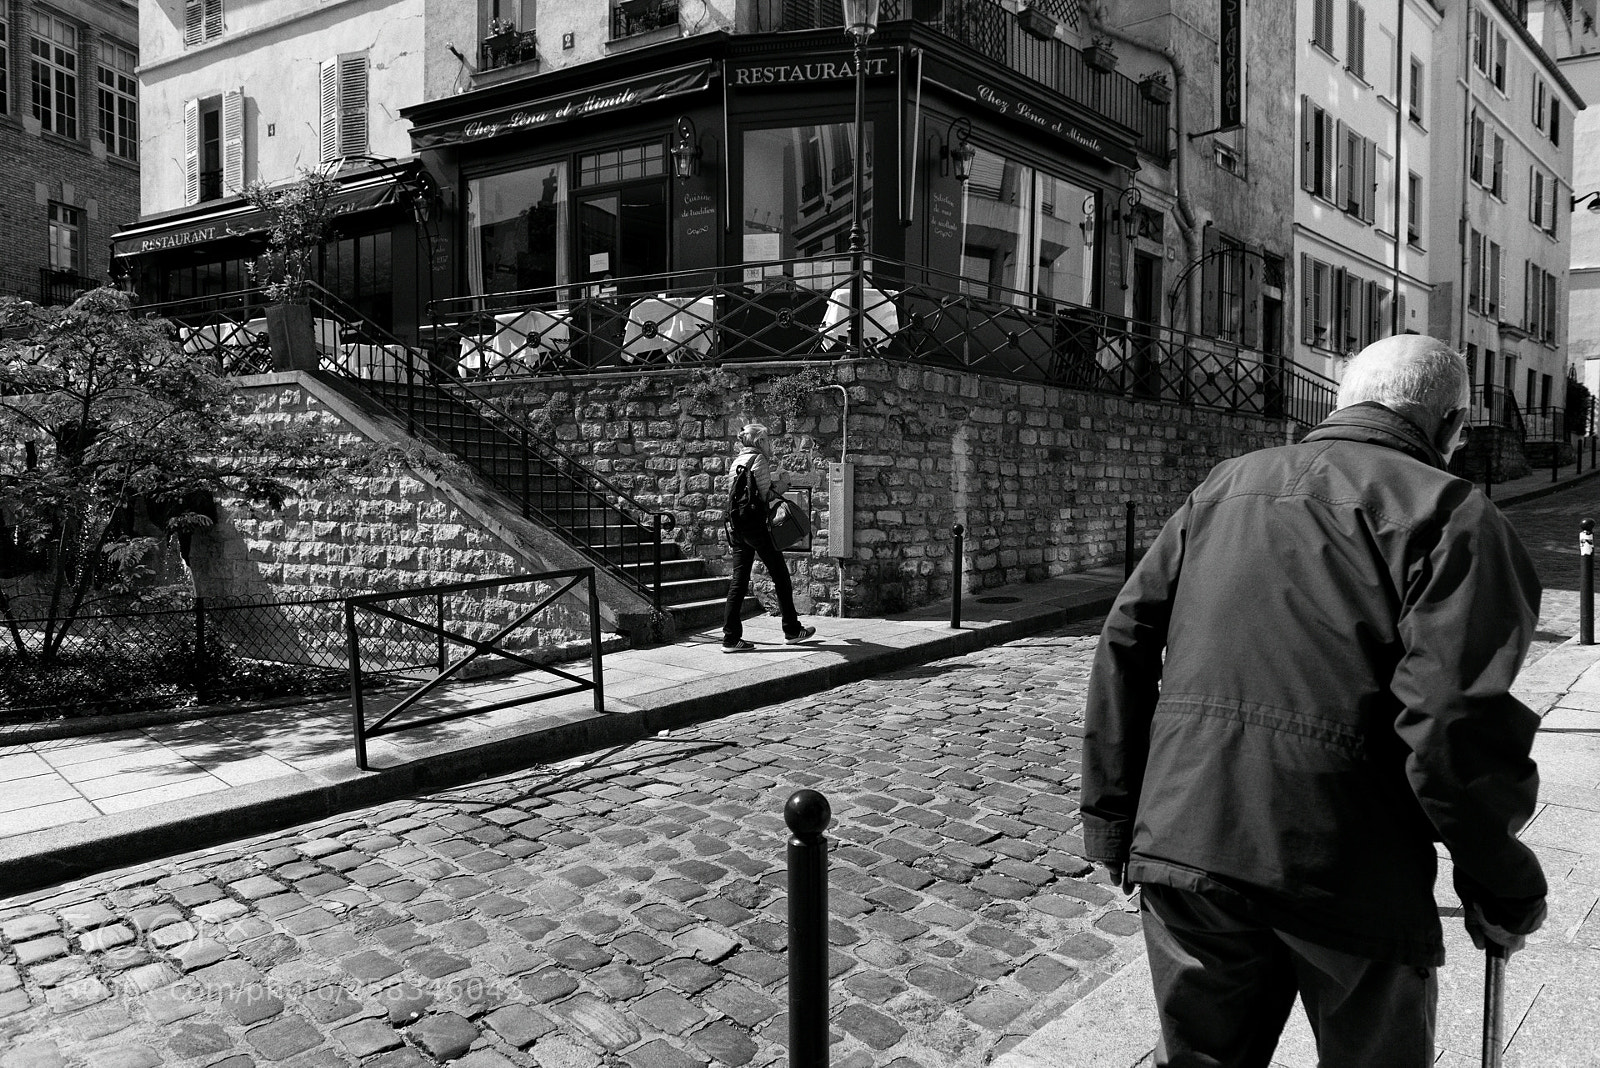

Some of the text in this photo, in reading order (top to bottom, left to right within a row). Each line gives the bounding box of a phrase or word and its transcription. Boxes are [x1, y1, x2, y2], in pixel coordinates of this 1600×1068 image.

[464, 121, 500, 138] Chez
[555, 102, 572, 118] et
[977, 84, 1009, 113] Chez
[1051, 122, 1063, 133] et
[1066, 127, 1102, 152] Mimile
[141, 227, 215, 251] RESTAURANT
